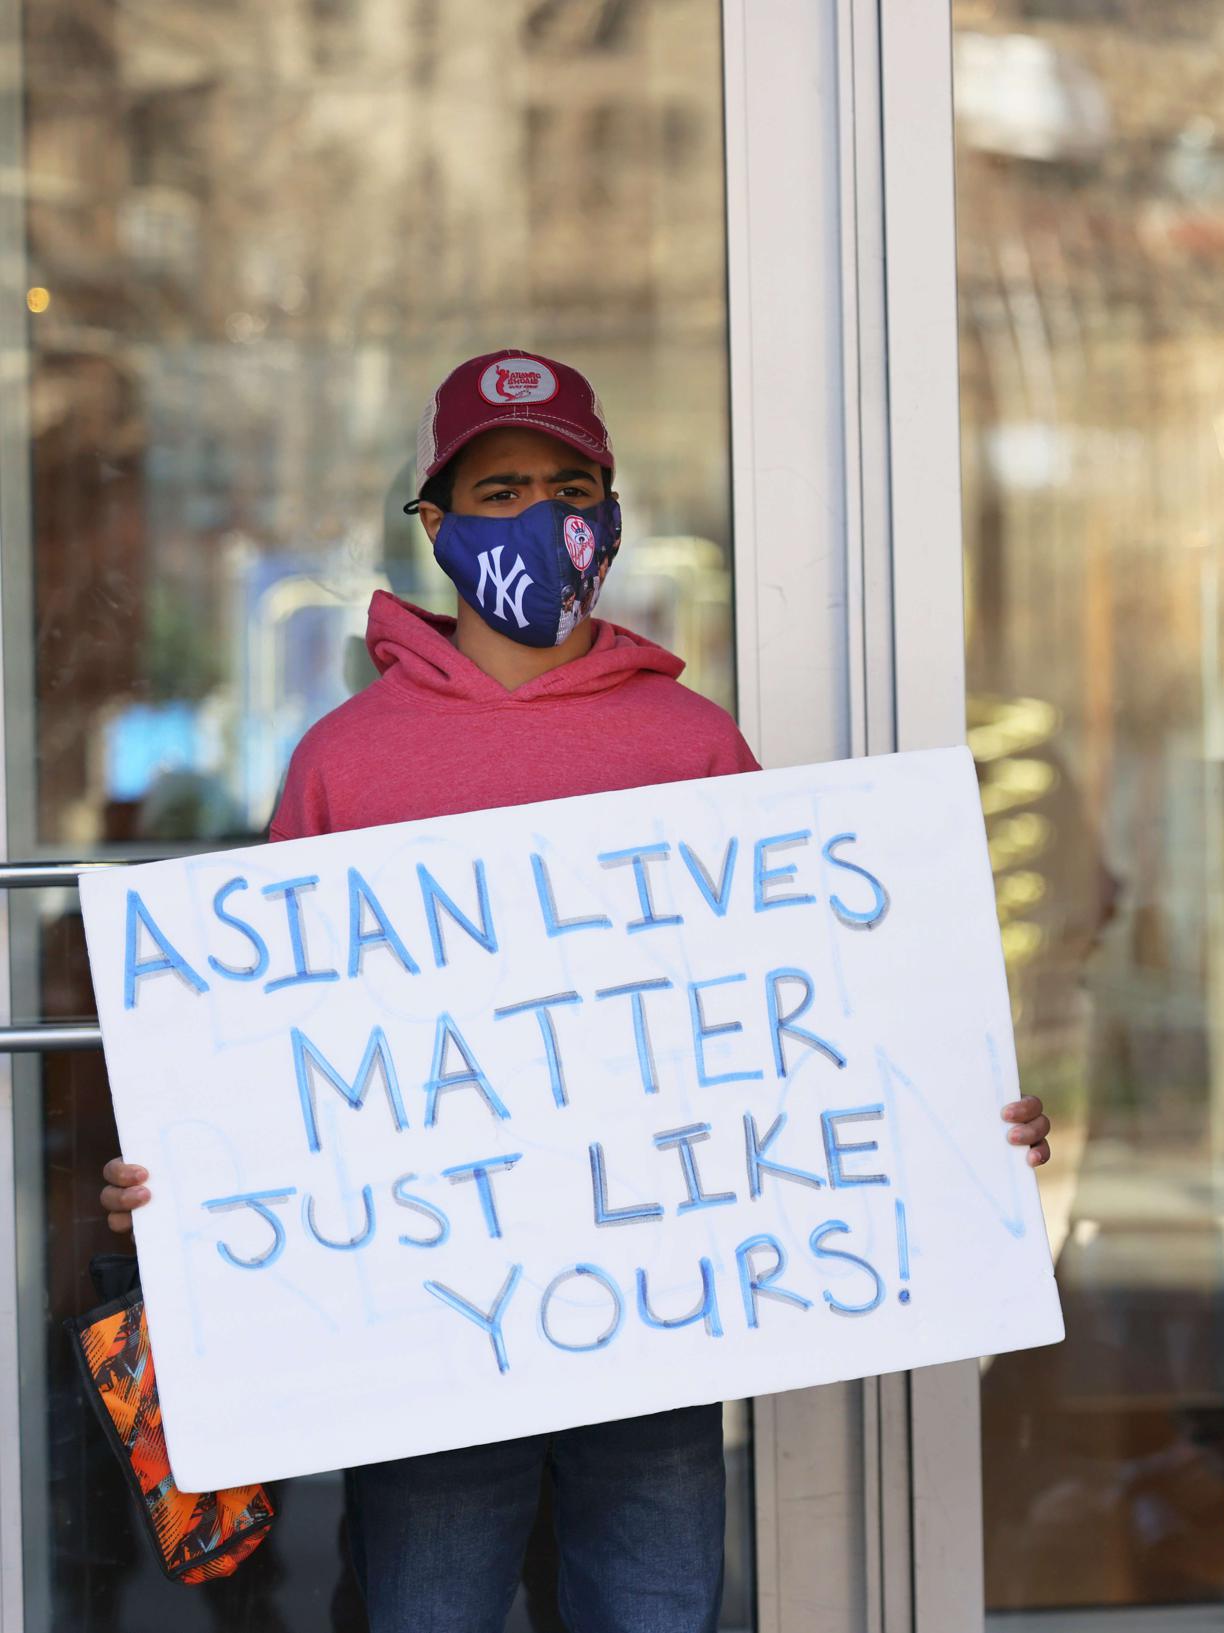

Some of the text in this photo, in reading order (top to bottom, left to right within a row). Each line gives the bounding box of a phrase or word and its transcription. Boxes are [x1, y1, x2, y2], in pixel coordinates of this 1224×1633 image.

[476, 544, 535, 629] NY
[124, 829, 890, 1010] ASIAN LIVES
[289, 967, 848, 1154] MATTER
[202, 1103, 892, 1270] JUST LIKE
[424, 1198, 912, 1374] YOURS!
